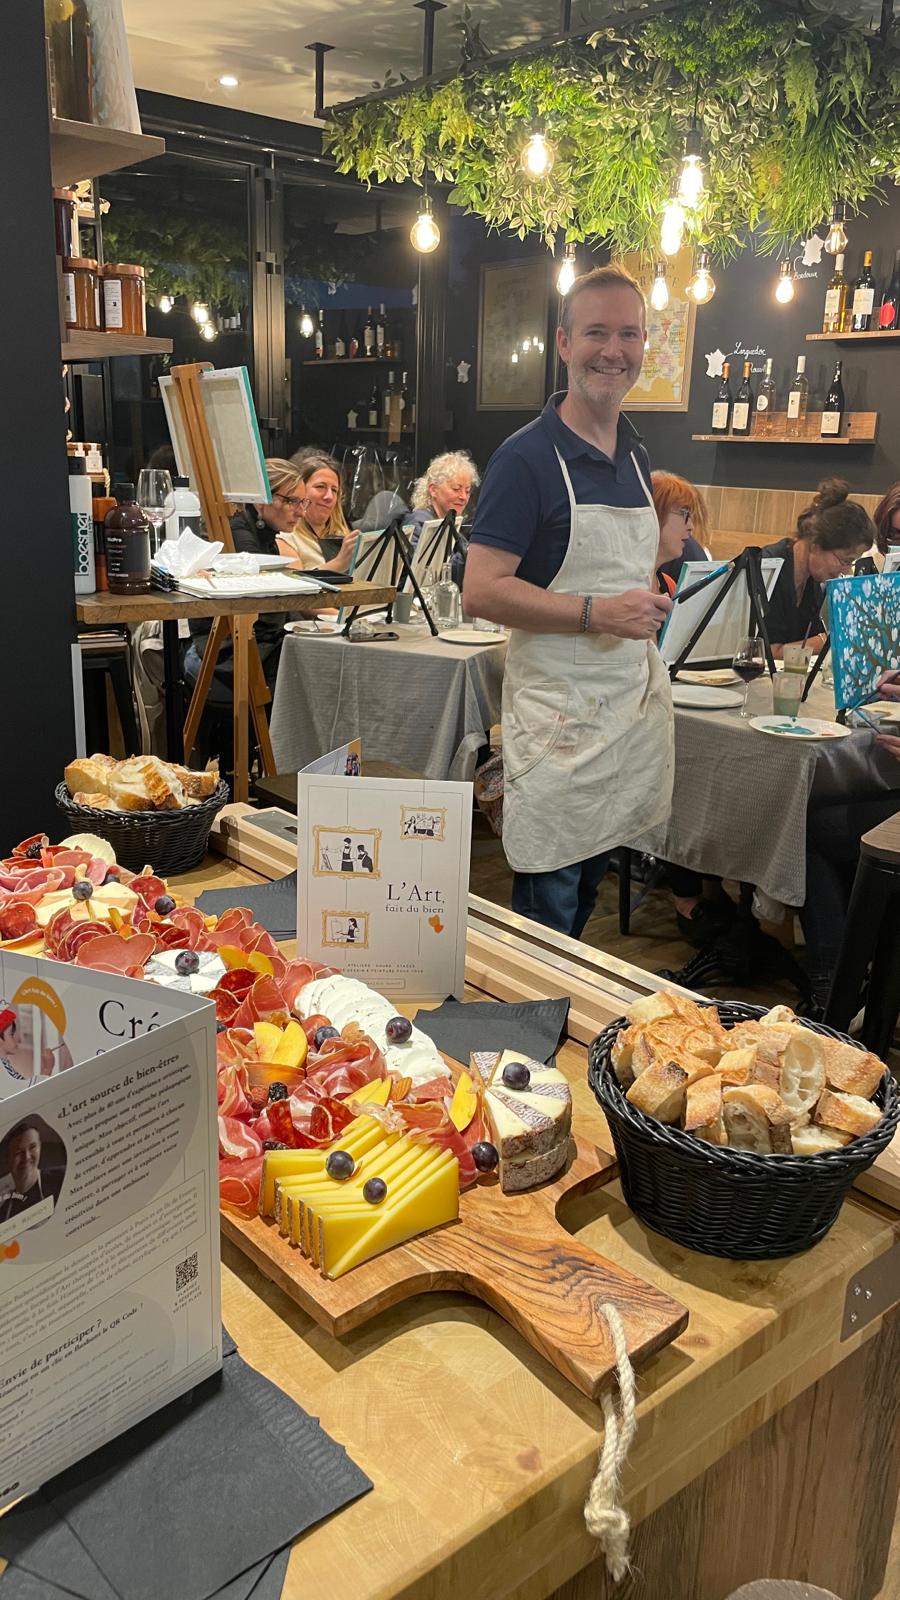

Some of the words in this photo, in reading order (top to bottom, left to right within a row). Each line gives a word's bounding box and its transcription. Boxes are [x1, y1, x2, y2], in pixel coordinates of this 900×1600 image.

[734, 342, 766, 360] Languedoc
[75, 512, 89, 576] boesner
[385, 904, 404, 912] fait
[406, 904, 418, 912] du
[422, 904, 444, 913] bien
[90, 1083, 120, 1103] source
[123, 1076, 134, 1086] de
[30, 1358, 42, 1370] de
[46, 1324, 95, 1362] participer
